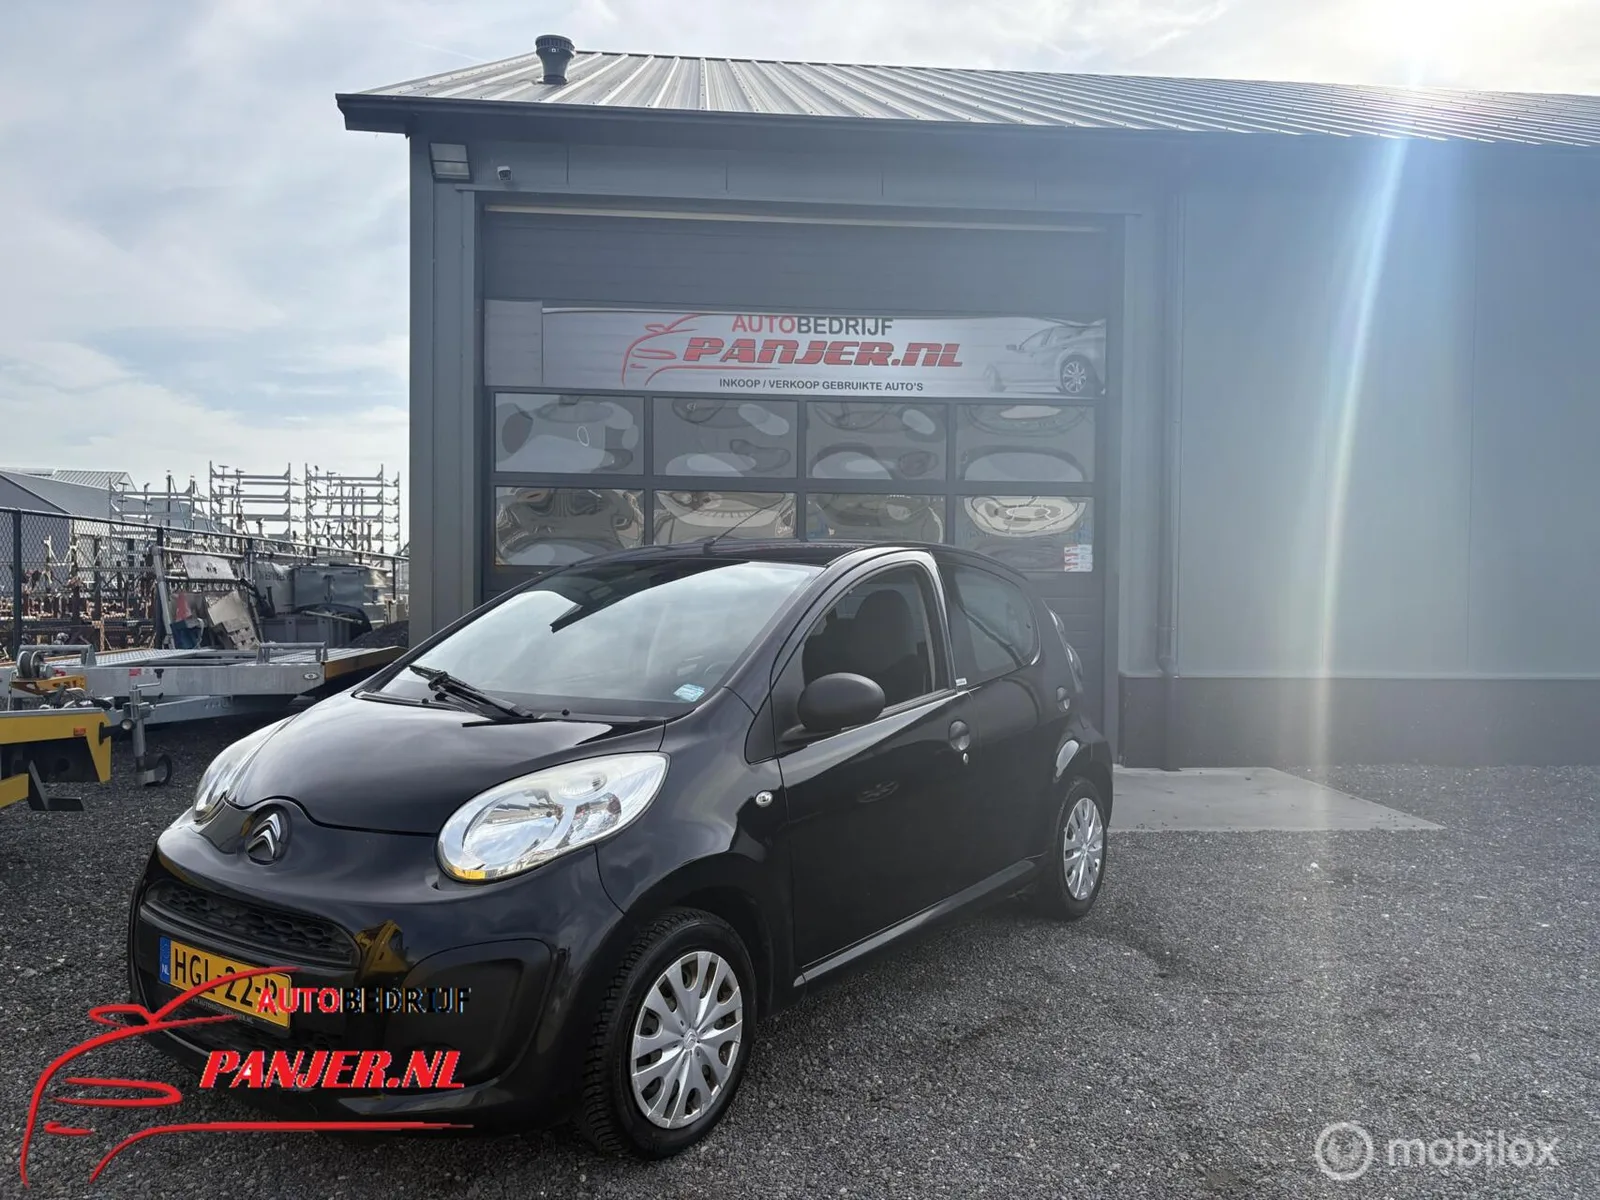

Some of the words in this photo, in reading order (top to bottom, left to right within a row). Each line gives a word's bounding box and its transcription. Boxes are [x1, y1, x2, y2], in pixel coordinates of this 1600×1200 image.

[731, 314, 895, 336] AUTOBEDRIJF
[719, 378, 760, 388] INKOOP
[769, 379, 820, 390] VERKOOP
[822, 380, 882, 391] GEBRUIKTE
[885, 382, 924, 391] AUTO'S
[161, 963, 170, 976] NL
